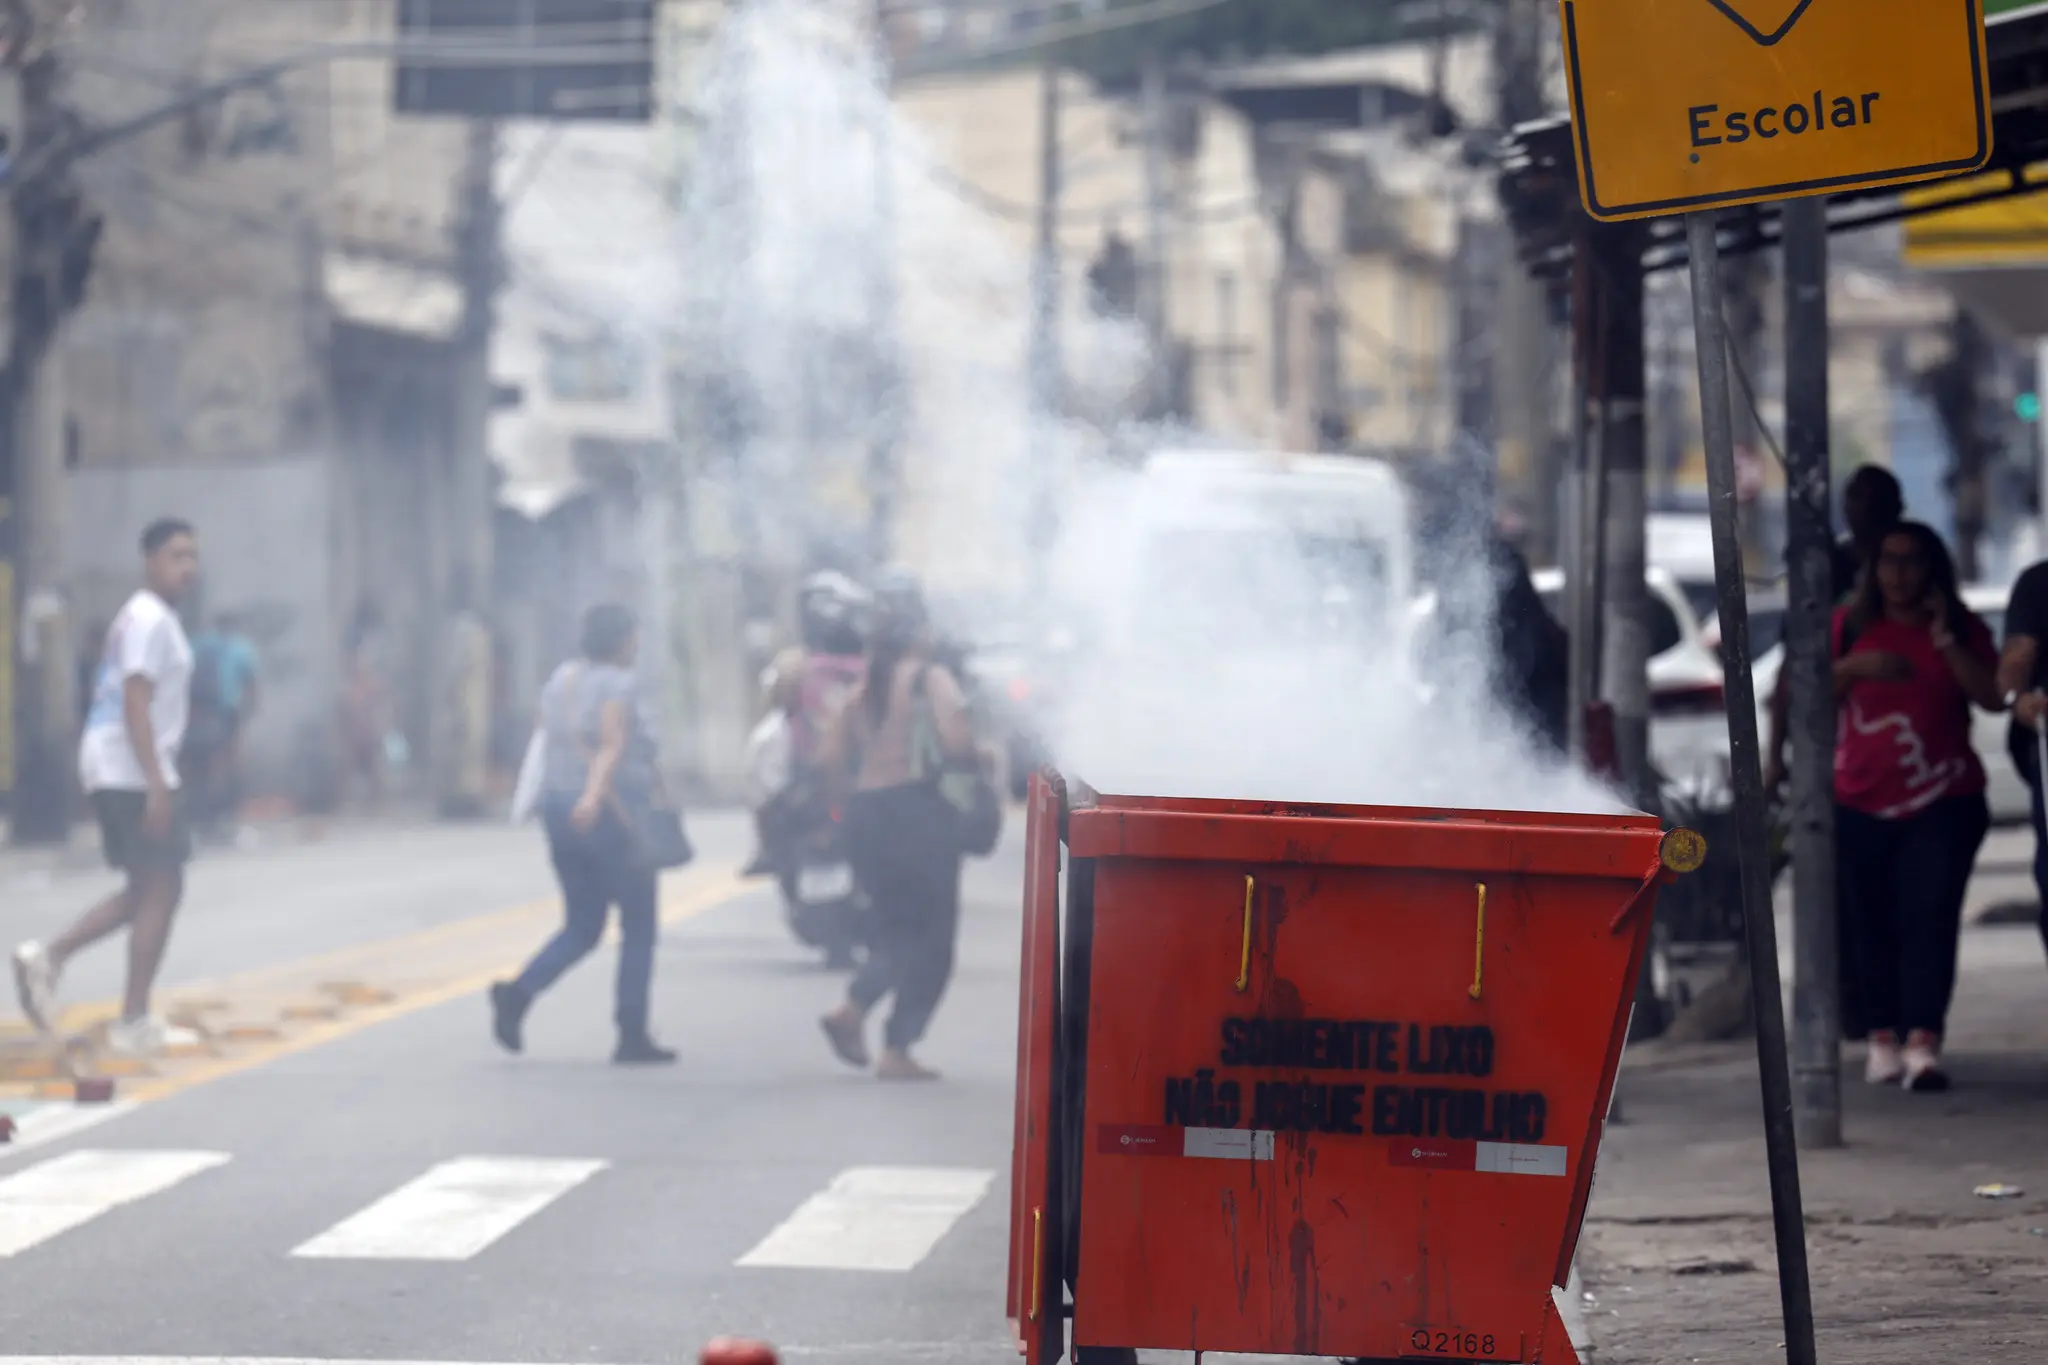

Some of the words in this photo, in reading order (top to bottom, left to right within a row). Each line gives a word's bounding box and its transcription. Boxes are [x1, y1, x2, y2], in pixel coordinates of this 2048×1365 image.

[1688, 90, 1880, 147] Escolar
[1407, 1023, 1494, 1077] LIXO
[1164, 1068, 1240, 1128] NÃO
[1373, 1085, 1547, 1143] ENTULHO
[1412, 1330, 1495, 1354] Q2168
